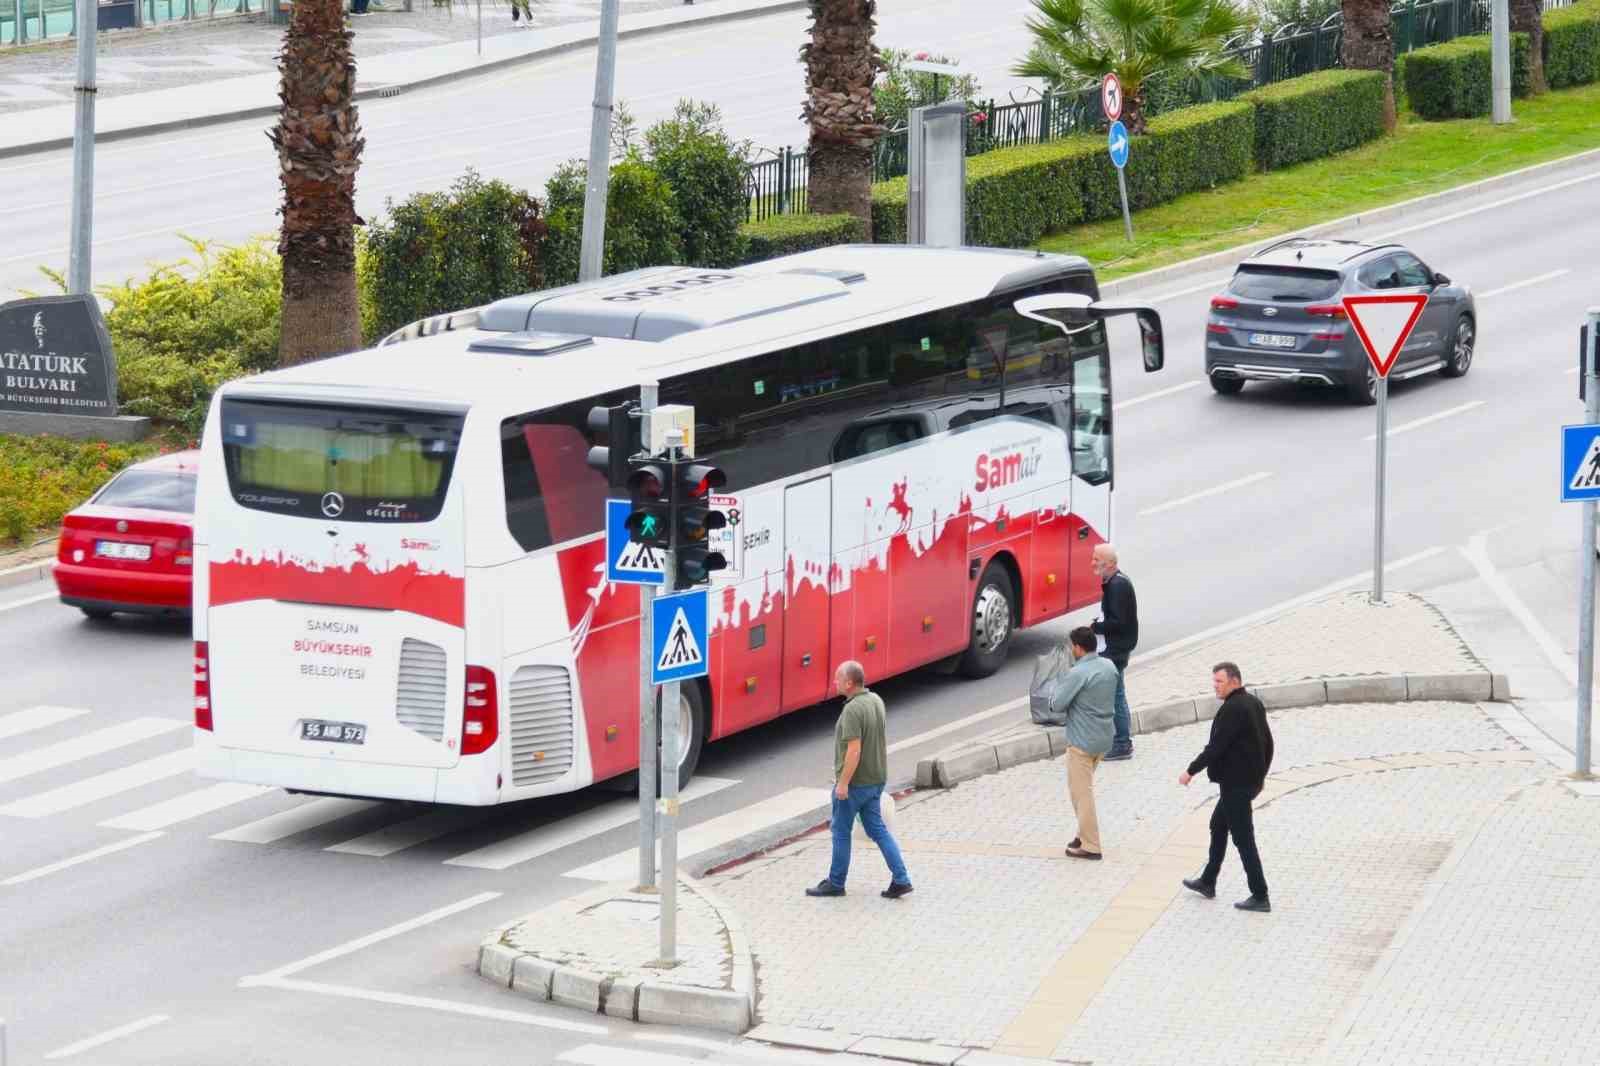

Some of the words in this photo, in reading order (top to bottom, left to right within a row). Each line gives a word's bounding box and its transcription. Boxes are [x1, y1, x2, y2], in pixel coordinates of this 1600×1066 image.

[6, 375, 76, 392] BULVARI
[976, 446, 1042, 493] Samair
[307, 619, 359, 634] SAMSUN
[344, 727, 364, 741] 573
